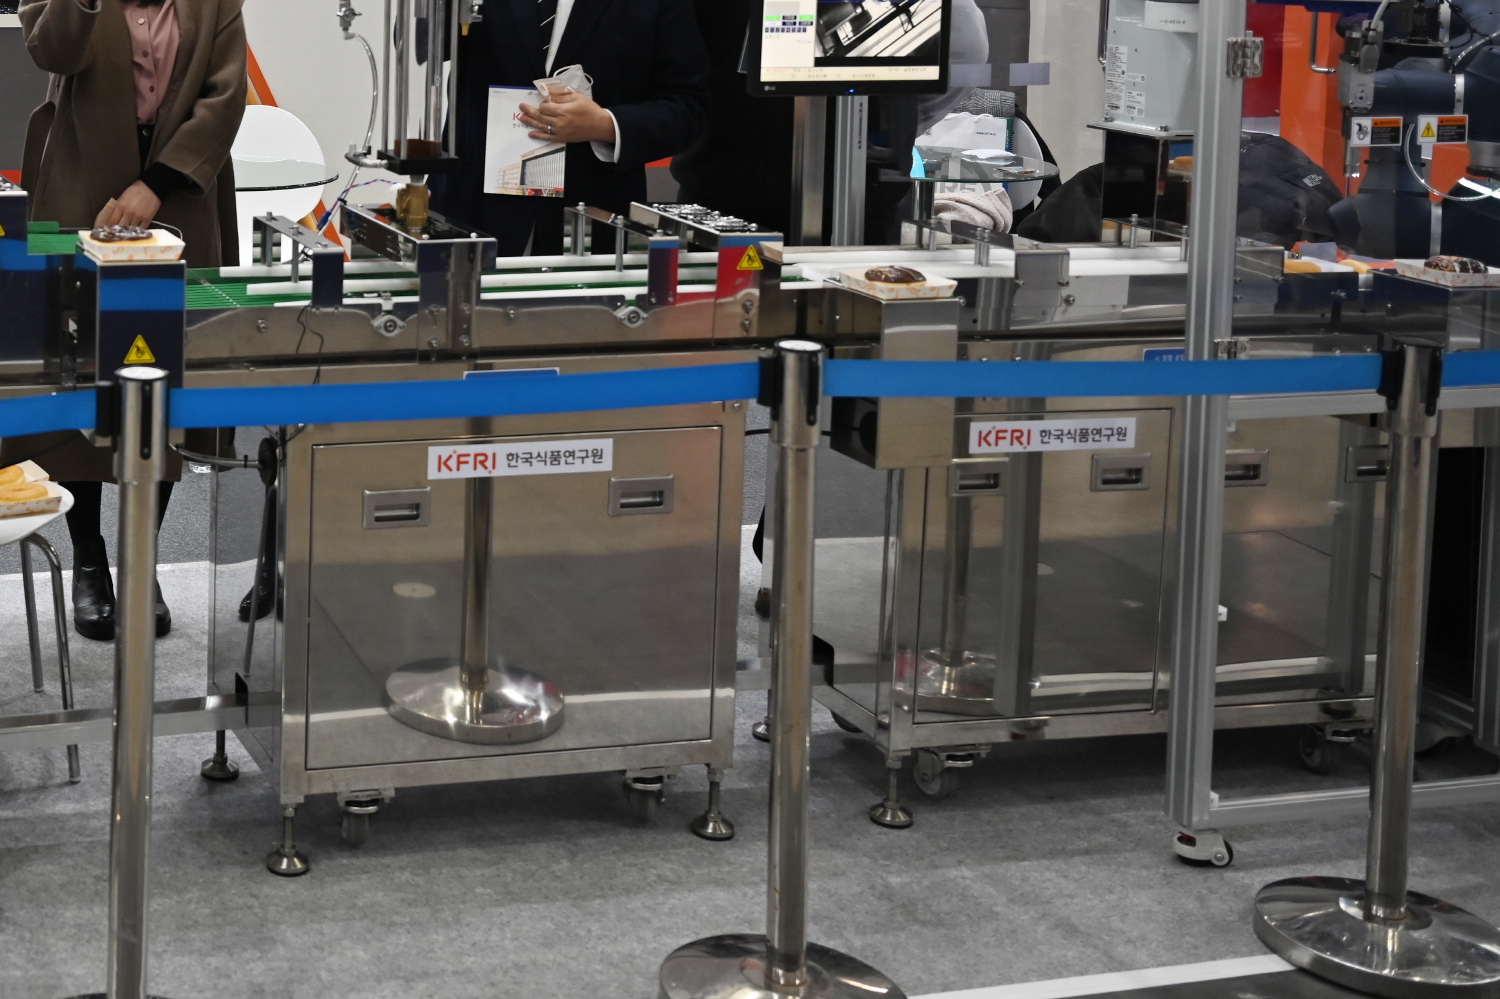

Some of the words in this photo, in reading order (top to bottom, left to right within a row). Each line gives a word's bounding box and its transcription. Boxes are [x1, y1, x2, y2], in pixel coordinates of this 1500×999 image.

[977, 426, 1031, 450] KFRI
[1040, 427, 1128, 444] 한국식품연구원
[437, 450, 496, 474] KFRI
[506, 448, 603, 469] 한국식품연구원
